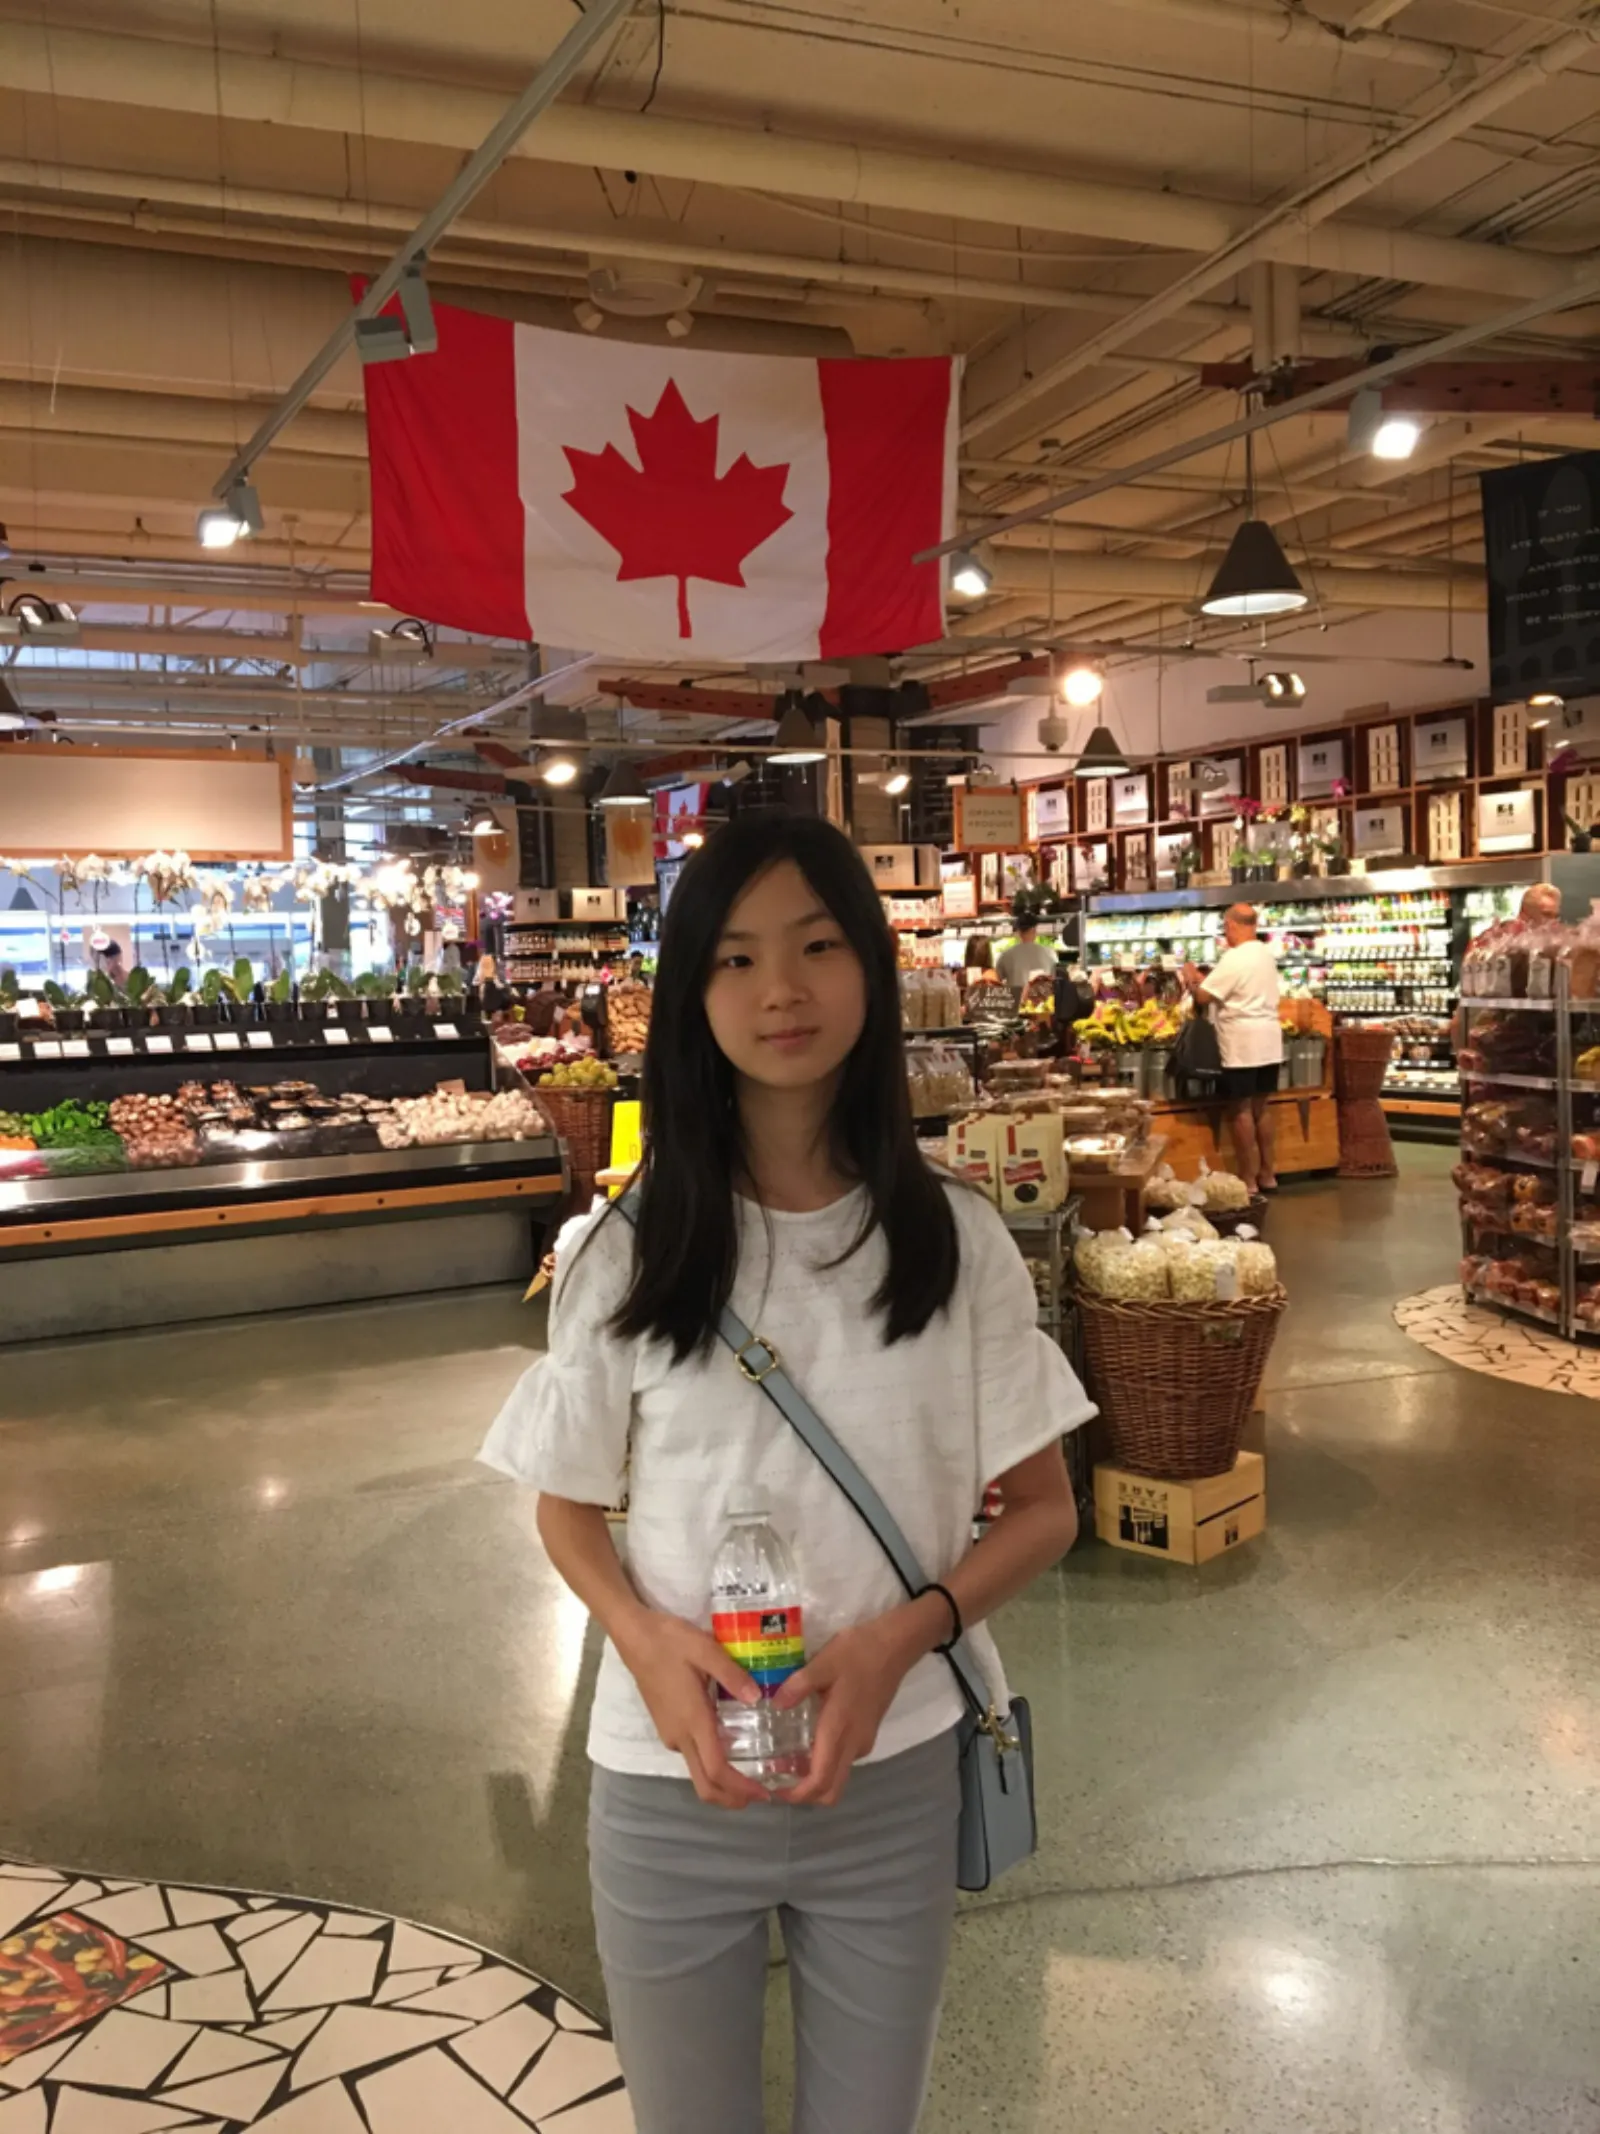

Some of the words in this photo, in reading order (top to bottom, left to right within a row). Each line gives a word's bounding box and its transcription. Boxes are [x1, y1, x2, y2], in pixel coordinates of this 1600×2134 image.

[1555, 504, 1582, 514] YOU
[1510, 540, 1533, 551] ATE
[1539, 531, 1580, 545] PASTA
[1505, 588, 1550, 604] WOULD
[1556, 583, 1582, 594] YOU
[1525, 616, 1542, 626] BE
[968, 819, 1013, 827] PRODUCE
